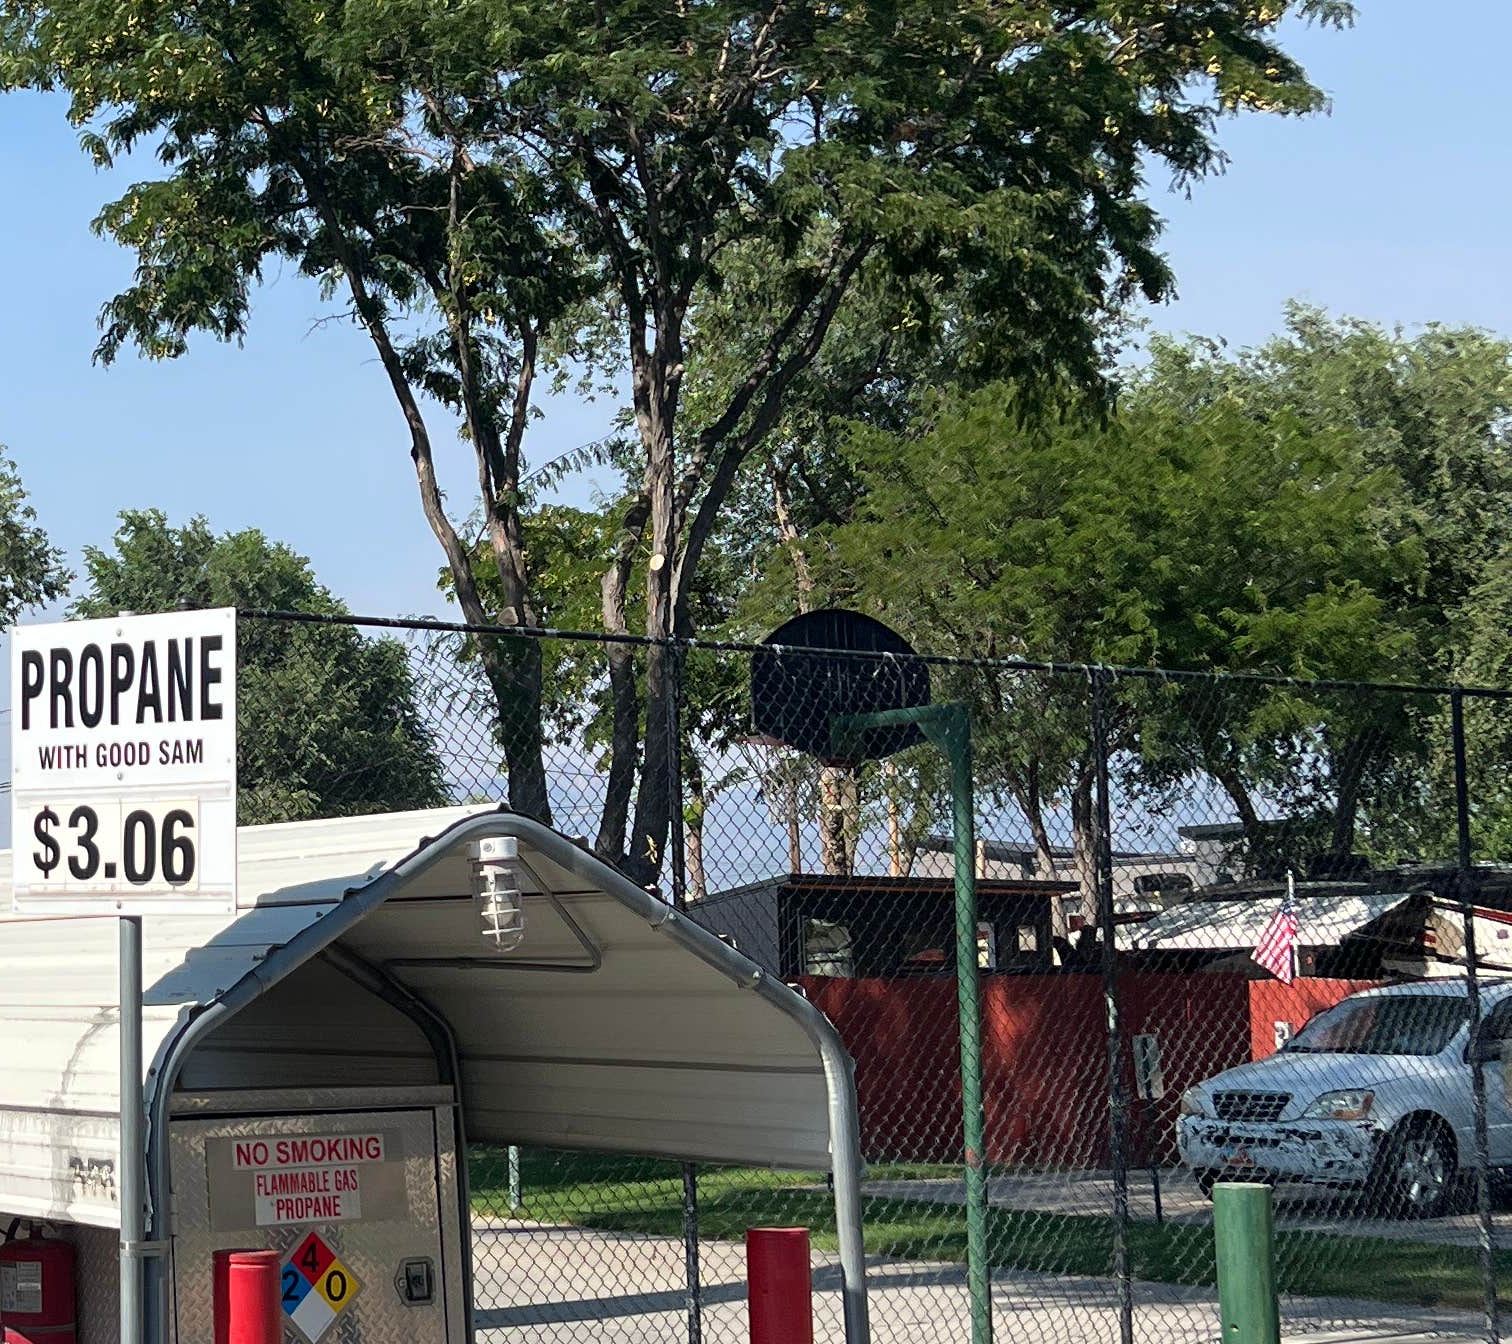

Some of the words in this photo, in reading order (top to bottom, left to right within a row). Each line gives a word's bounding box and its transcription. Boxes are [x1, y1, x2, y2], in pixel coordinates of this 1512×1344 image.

[21, 635, 223, 730] PROPANE
[38, 744, 88, 770] WITH
[96, 741, 151, 768] GOOD
[158, 739, 204, 765] SAM
[33, 805, 196, 886] $3.06
[236, 1142, 269, 1166] NO
[276, 1137, 381, 1164] SMOKING
[256, 1171, 330, 1197] FLAMMABLE
[334, 1169, 358, 1192] GAS
[276, 1196, 341, 1220] PROPANE
[301, 1243, 320, 1273] 4
[282, 1270, 299, 1301] 2
[325, 1270, 347, 1302] 0
